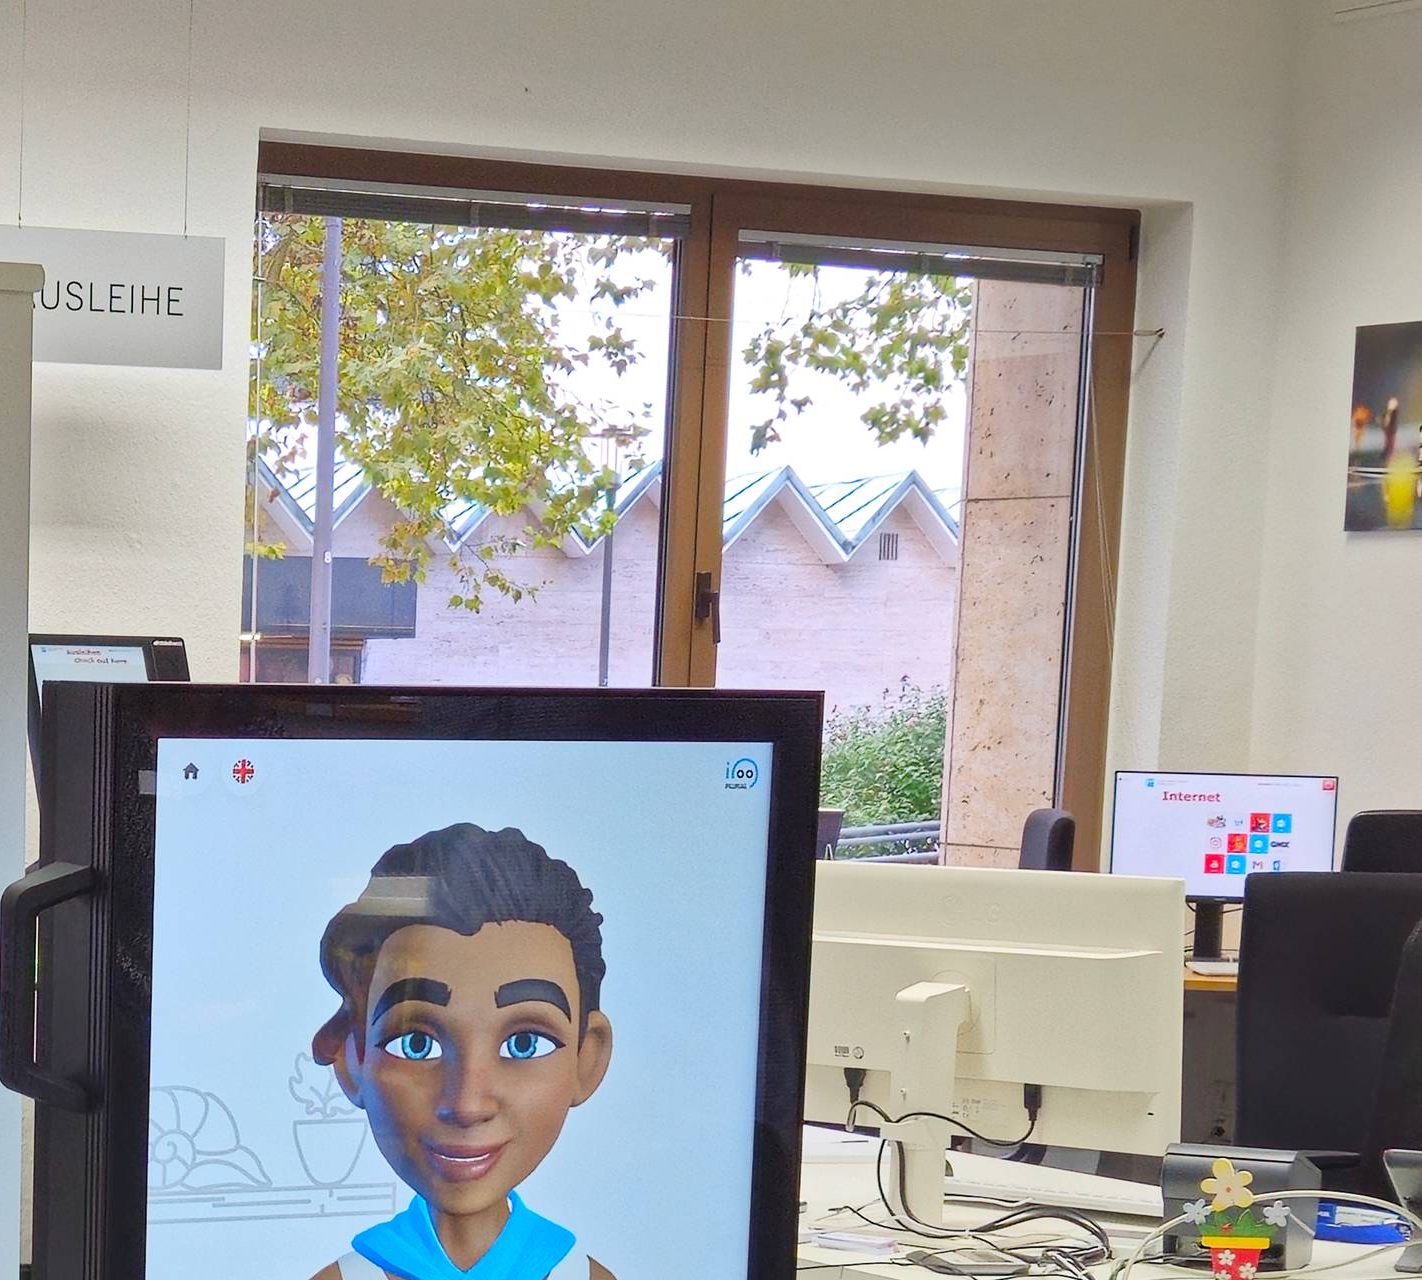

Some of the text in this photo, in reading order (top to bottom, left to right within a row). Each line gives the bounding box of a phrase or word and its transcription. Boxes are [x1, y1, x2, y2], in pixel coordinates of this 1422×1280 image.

[33, 280, 184, 316] USLEIHE
[324, 551, 332, 563] 8
[1162, 791, 1221, 803] Internet
